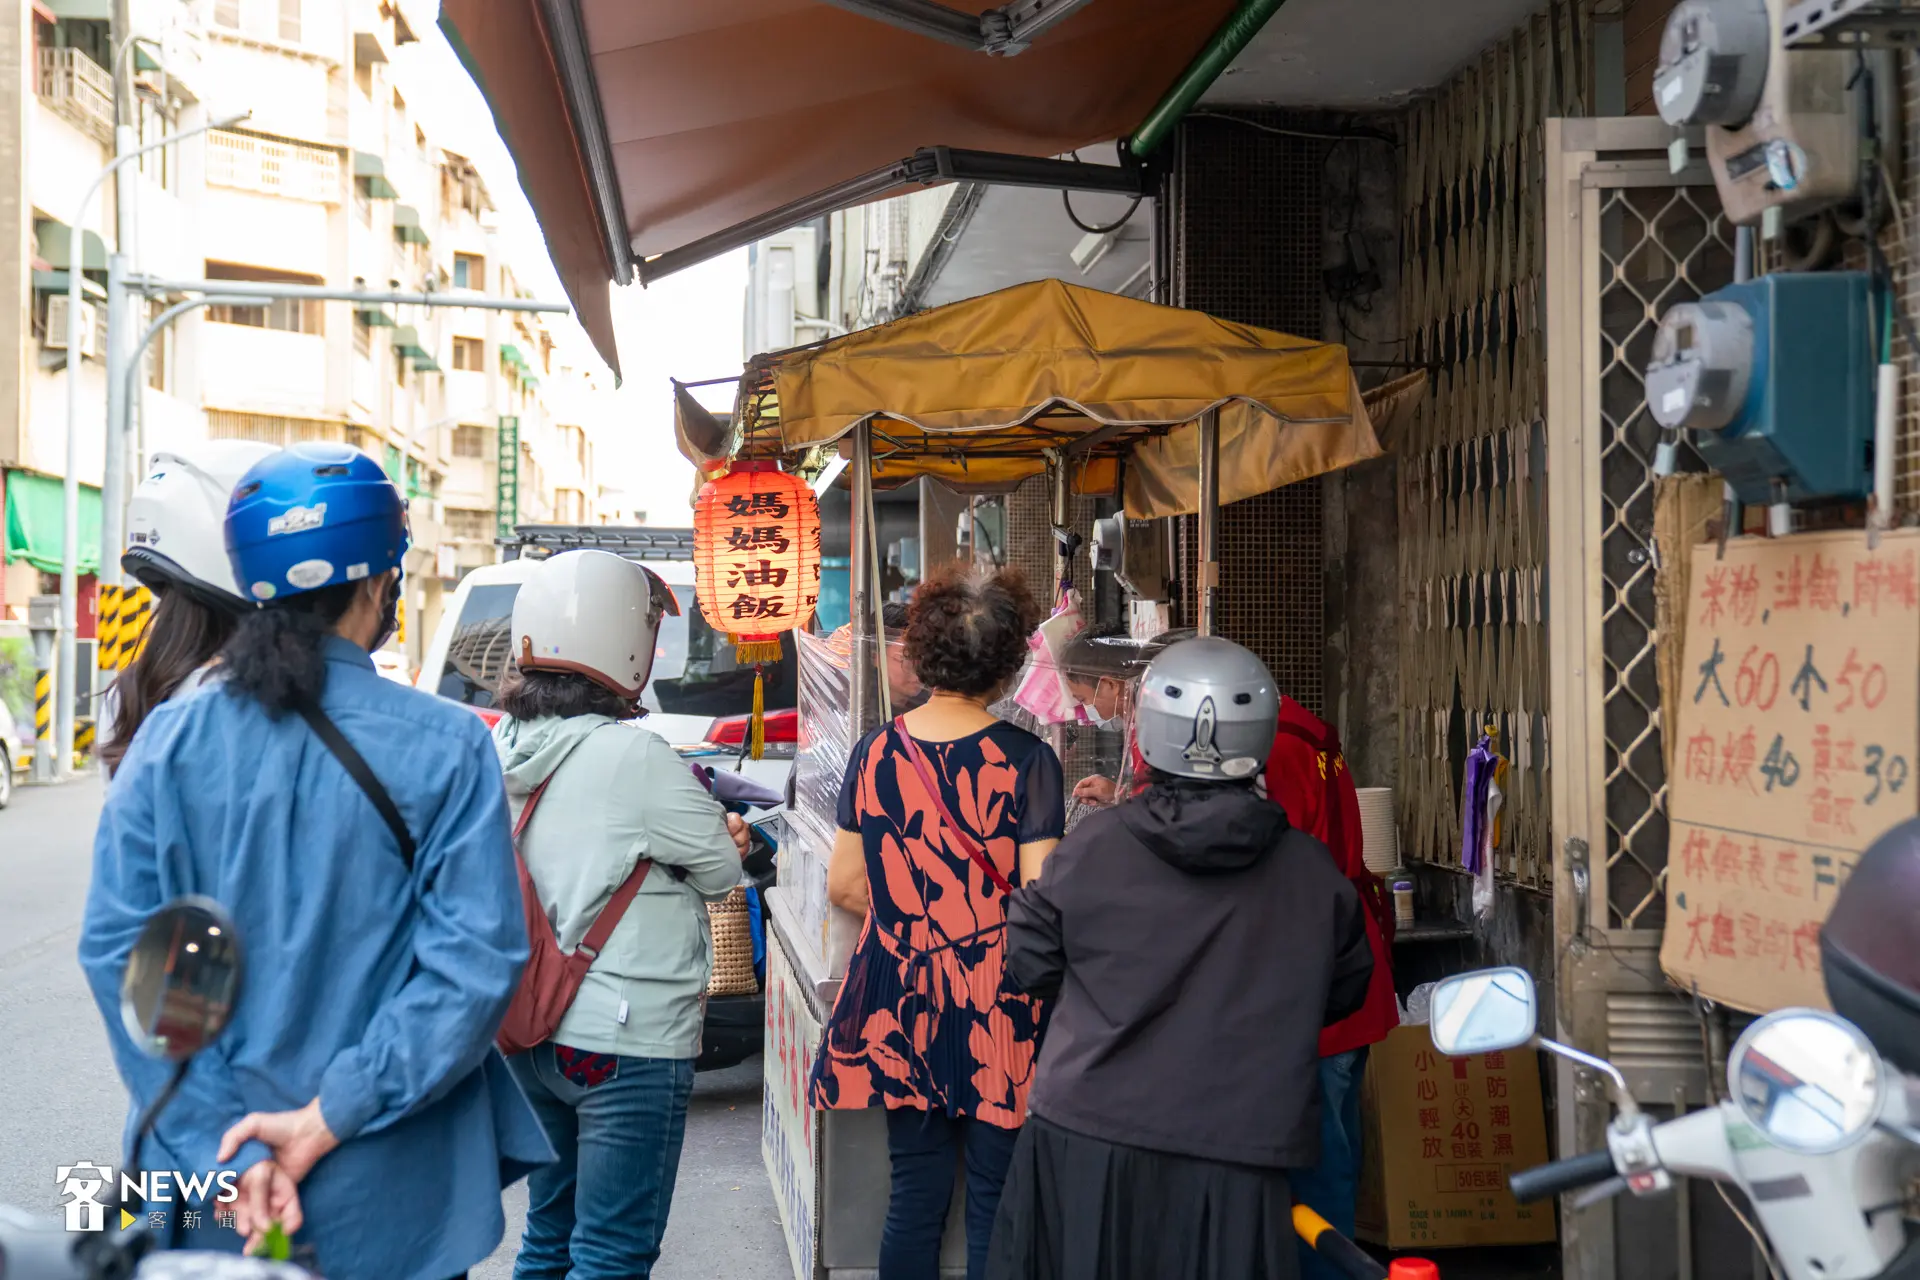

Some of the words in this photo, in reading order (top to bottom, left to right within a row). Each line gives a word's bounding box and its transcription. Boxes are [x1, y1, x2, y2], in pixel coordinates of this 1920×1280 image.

[723, 491, 790, 620] 媽媽油飯
[1864, 744, 1908, 806] 30
[1454, 1082, 1470, 1097] UP
[1415, 1051, 1443, 1159] 小心輕放
[1484, 1052, 1514, 1156] 謹防潮濕
[1451, 1122, 1479, 1140] 40
[1451, 1142, 1483, 1159] 包裝
[1458, 1171, 1500, 1188] 50包裝
[1409, 1210, 1429, 1219] MADE
[1433, 1209, 1441, 1218] IN
